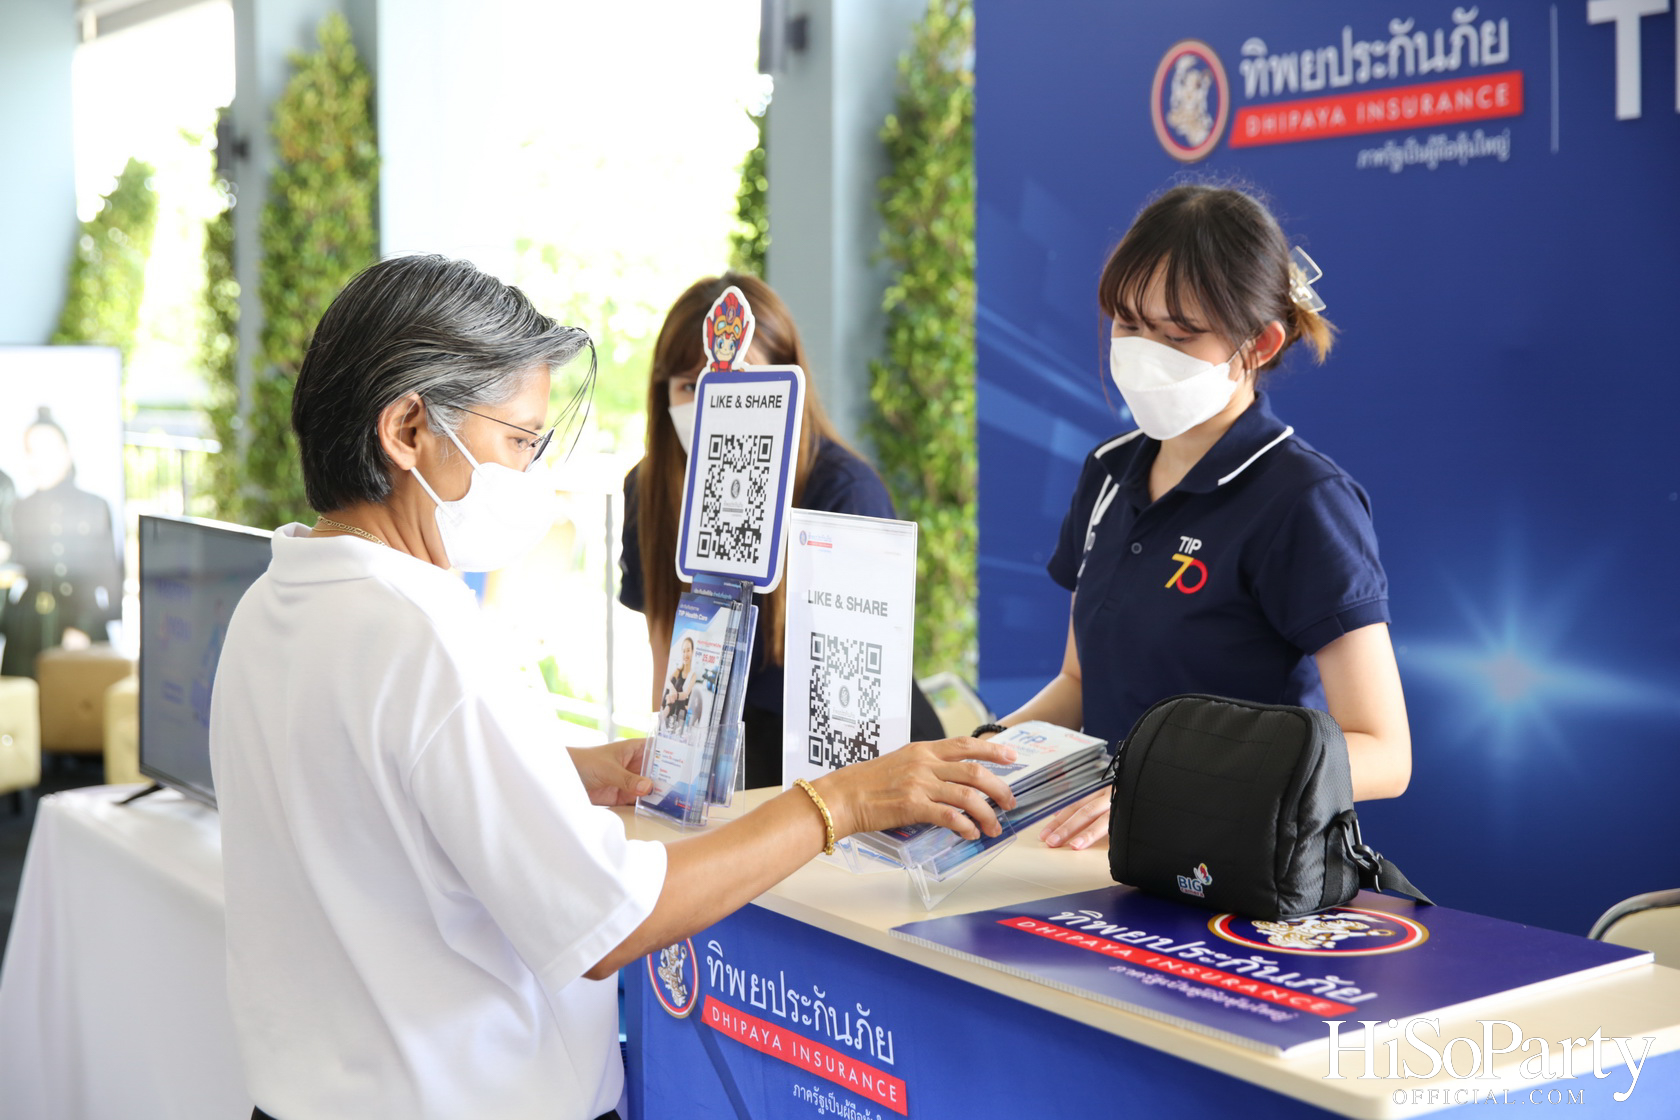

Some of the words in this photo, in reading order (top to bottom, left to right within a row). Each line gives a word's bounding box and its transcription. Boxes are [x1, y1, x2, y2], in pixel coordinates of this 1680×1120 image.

[1239, 6, 1510, 97] ทิพยประกันภัย
[1586, 0, 1680, 120] T
[1245, 105, 1346, 137] DHIPAYA
[1356, 82, 1511, 123] INSURANCE
[710, 394, 733, 409] LIKE
[735, 394, 743, 409] &
[745, 394, 783, 409] SHARE
[1164, 553, 1208, 594] 70
[1178, 535, 1203, 555] TIP
[808, 589, 832, 607] LIKE
[835, 594, 844, 609] &
[846, 596, 888, 617] SHARE
[1178, 876, 1202, 892] BIG
[1016, 920, 1133, 958] DHIPAYA
[1145, 956, 1333, 1013] INSURANCE
[1048, 909, 1378, 1002] ทิพยประกันภัย
[706, 939, 895, 1066] ทิพยประกันภัย
[712, 1006, 783, 1051] DHIPAYA
[792, 1041, 898, 1103] INSURANCE
